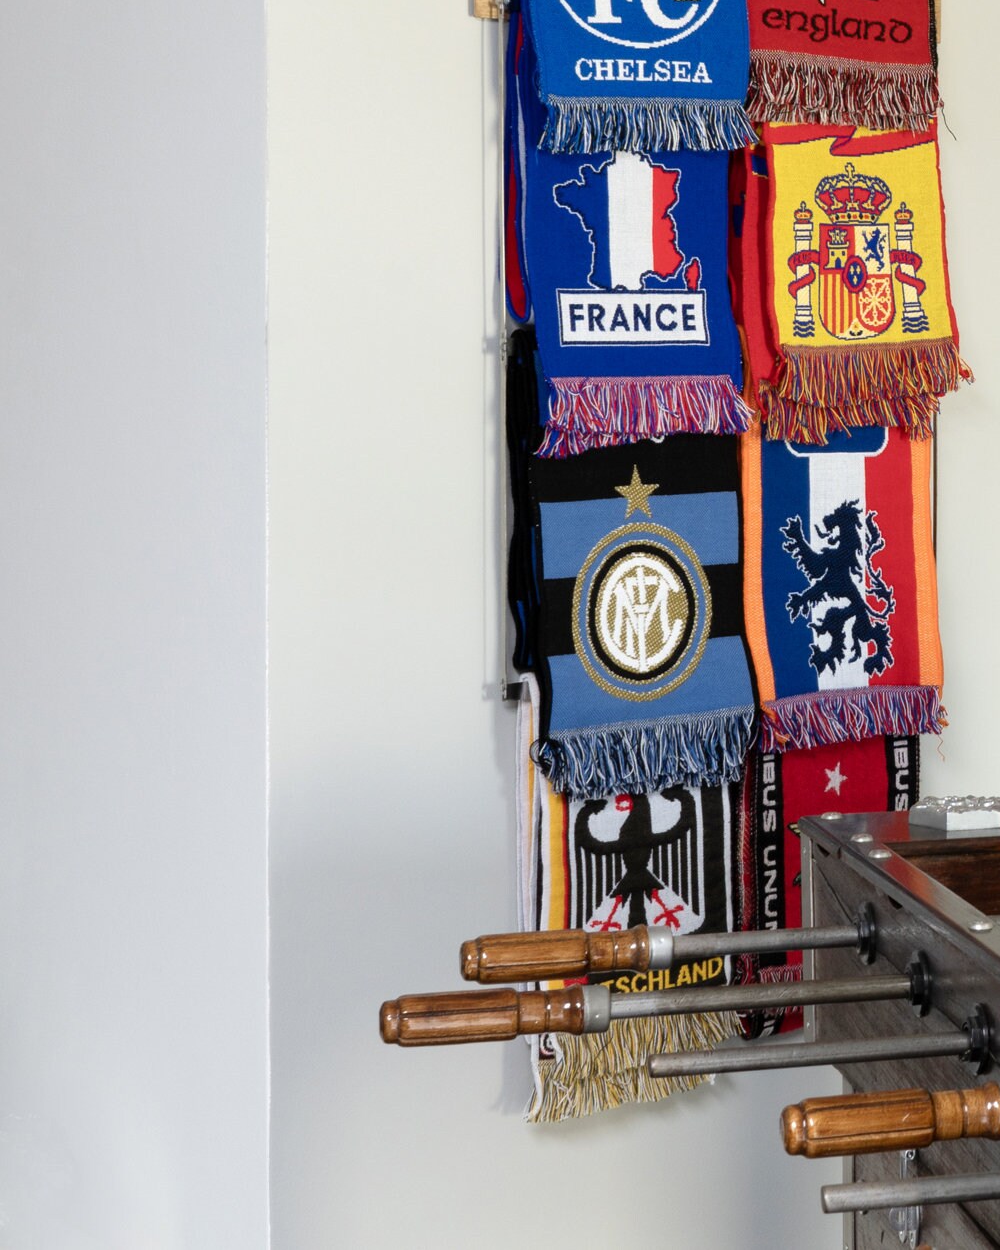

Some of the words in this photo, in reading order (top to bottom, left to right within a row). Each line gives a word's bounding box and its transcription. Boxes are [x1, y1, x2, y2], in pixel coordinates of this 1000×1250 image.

[762, 6, 914, 43] england
[575, 58, 713, 85] CHELSEA
[568, 302, 697, 333] FRANCE
[762, 754, 778, 833] IBUS
[893, 739, 909, 812] IBUS
[600, 956, 724, 994] TSCHLAND
